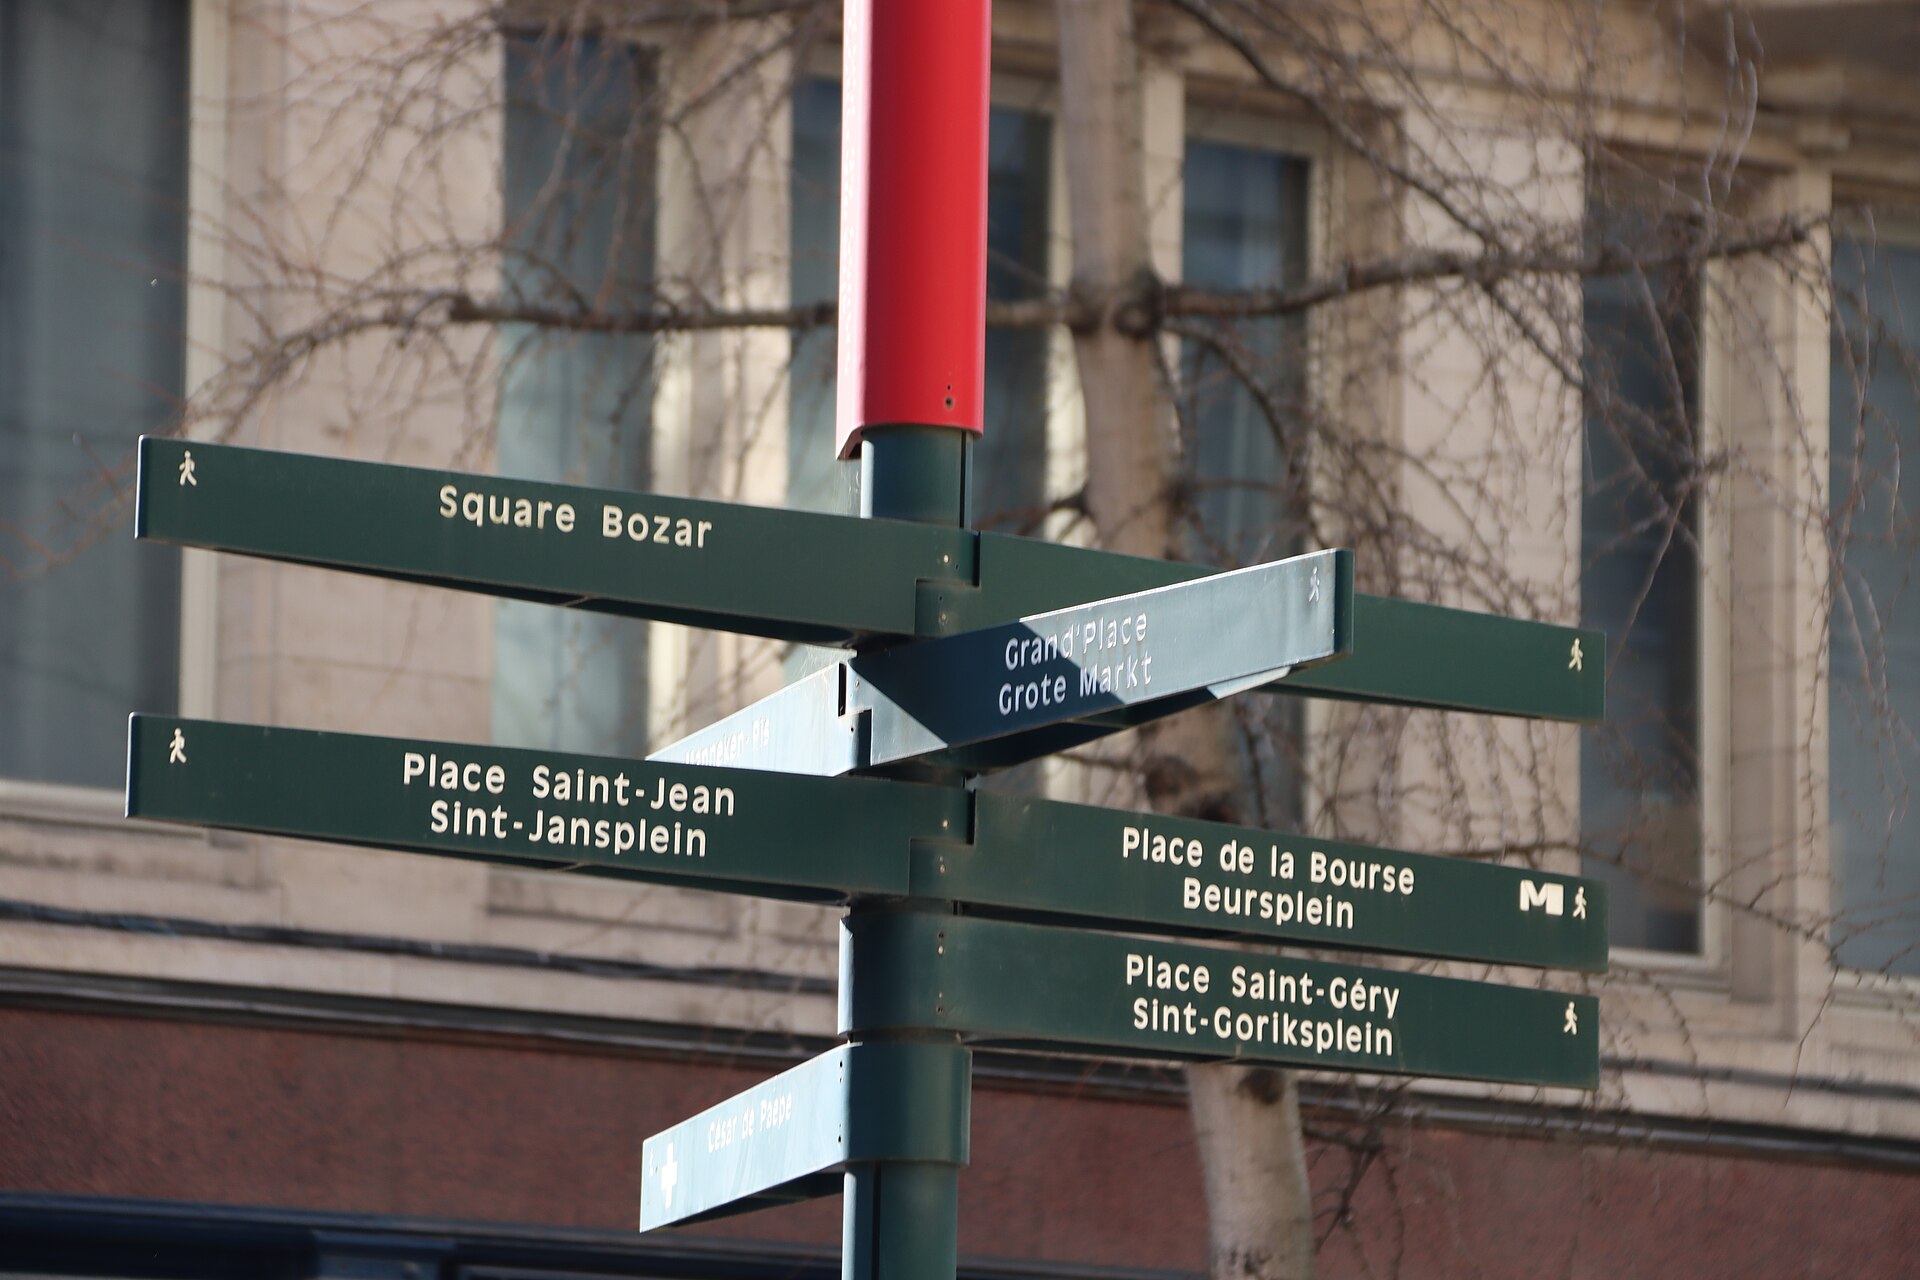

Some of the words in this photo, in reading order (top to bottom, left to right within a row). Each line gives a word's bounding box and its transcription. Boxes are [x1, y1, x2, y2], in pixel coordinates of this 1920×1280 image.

[439, 484, 576, 533] Square
[602, 504, 713, 549] Bozar
[1004, 612, 1148, 671] Grand'Place
[998, 673, 1068, 716] Grote
[1079, 650, 1153, 698] Markt
[403, 752, 506, 794] Place
[532, 764, 735, 817] Saint-Jean
[430, 799, 706, 857] Sint-Jansplein
[1122, 826, 1203, 868] Place
[1219, 839, 1255, 875] de
[1270, 844, 1295, 880] la
[1310, 851, 1415, 896] Bourse
[1183, 876, 1354, 930] Beursplein
[1126, 953, 1210, 994] Place
[1231, 965, 1400, 1020] Saint-Géry
[1133, 997, 1393, 1057] Sint-Goriksplein
[741, 1106, 755, 1140] de
